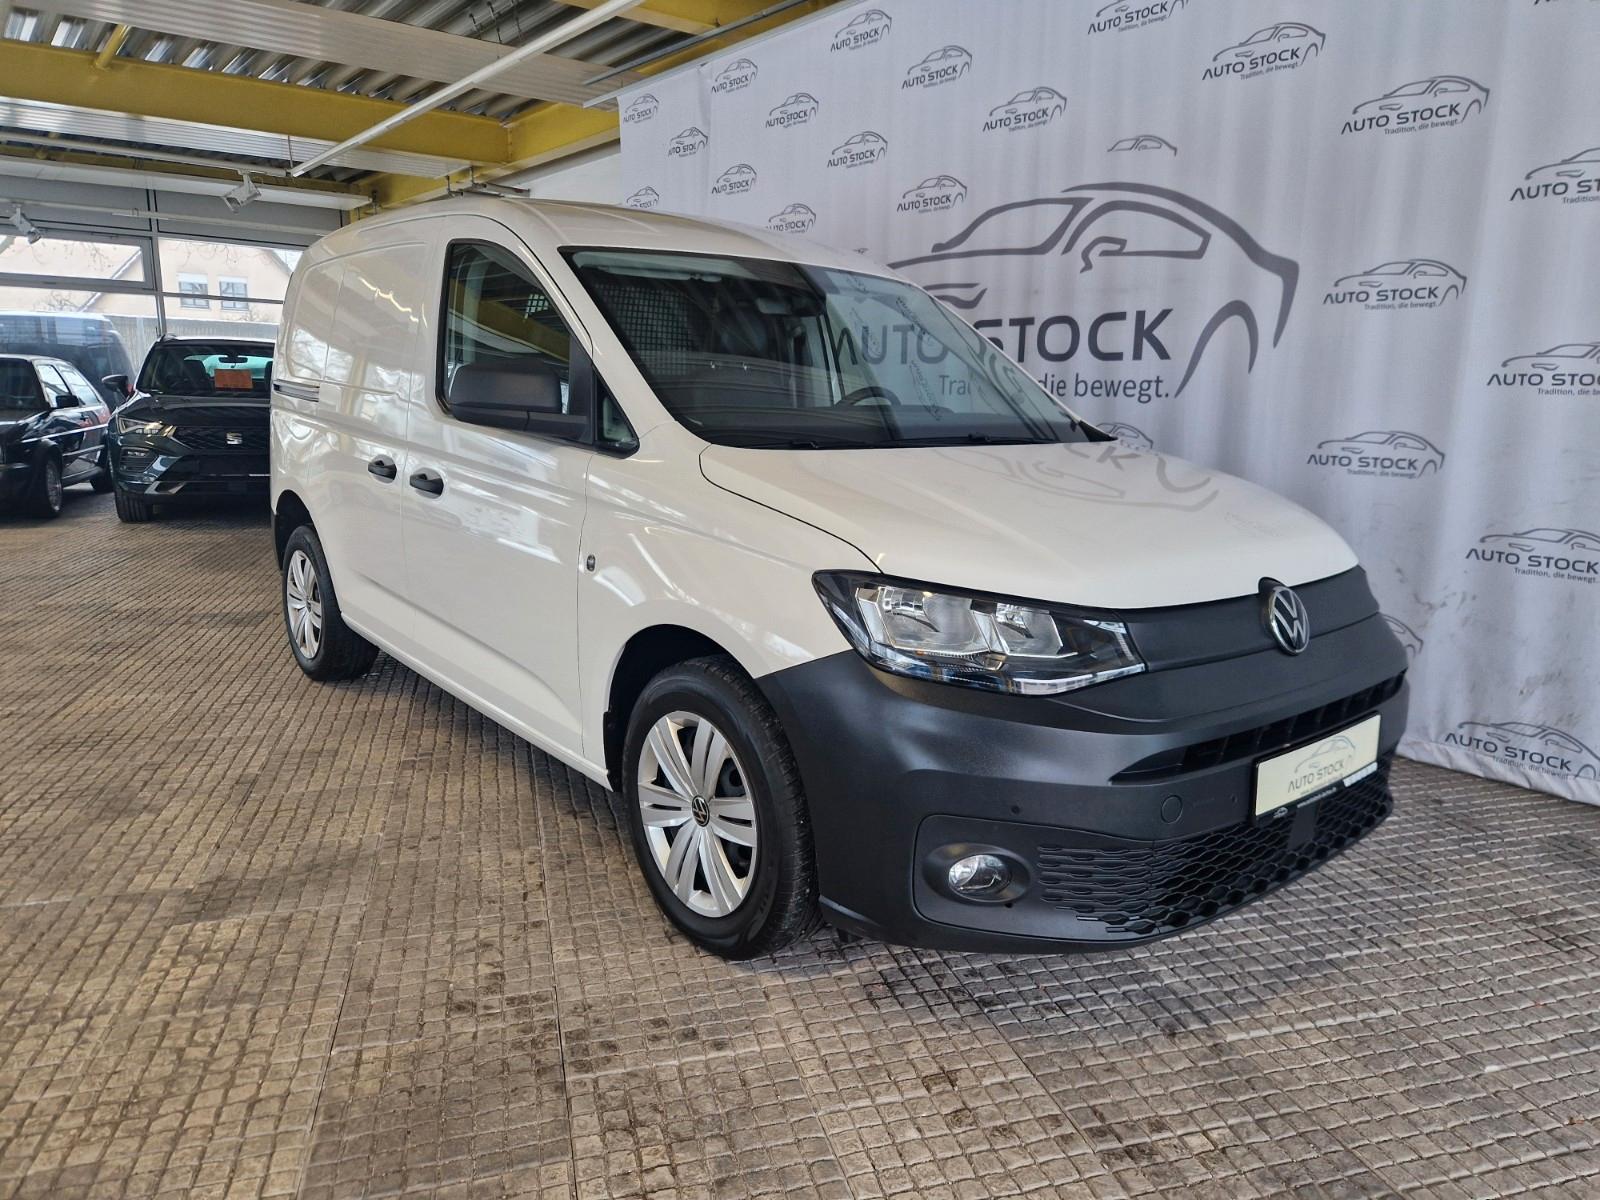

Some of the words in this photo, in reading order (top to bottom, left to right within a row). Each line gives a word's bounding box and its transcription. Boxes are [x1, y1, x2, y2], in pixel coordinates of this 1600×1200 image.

[1088, 16, 1122, 35] AUTO
[1125, 1, 1168, 23] STOCK
[830, 38, 851, 52] AUTO
[853, 27, 880, 44] STOCK
[901, 74, 925, 90] AUTO
[927, 63, 958, 81] STOCK
[1202, 61, 1245, 81] AUTO
[1249, 47, 1300, 70] STOCK
[729, 73, 749, 88] STOCK
[765, 116, 785, 129] AUTO
[786, 109, 808, 123] STOCK
[982, 116, 1012, 133] AUTO
[1014, 106, 1049, 125] STOCK
[1341, 114, 1390, 135] AUTO
[1396, 103, 1461, 126] STOCK
[827, 155, 848, 168] AUTO
[849, 148, 876, 163] STOCK
[729, 179, 750, 191] STOCK
[1510, 182, 1569, 202] AUTO
[897, 200, 921, 212] AUTO
[922, 193, 952, 209] STOCK
[1323, 290, 1370, 305] AUTO
[1376, 286, 1439, 302] STOCK
[835, 324, 949, 366] AUTO
[1073, 372, 1169, 404] bewegt.
[1486, 373, 1544, 387] AUTO
[1307, 453, 1352, 468] AUTO
[1358, 456, 1418, 471] STOCK
[1465, 548, 1520, 566] AUTO
[1527, 555, 1600, 575] STOCK
[1445, 732, 1498, 754] AUTO
[1504, 745, 1572, 772] STOCK
[1287, 772, 1315, 793] AUTO
[1316, 759, 1345, 781] STOCK
